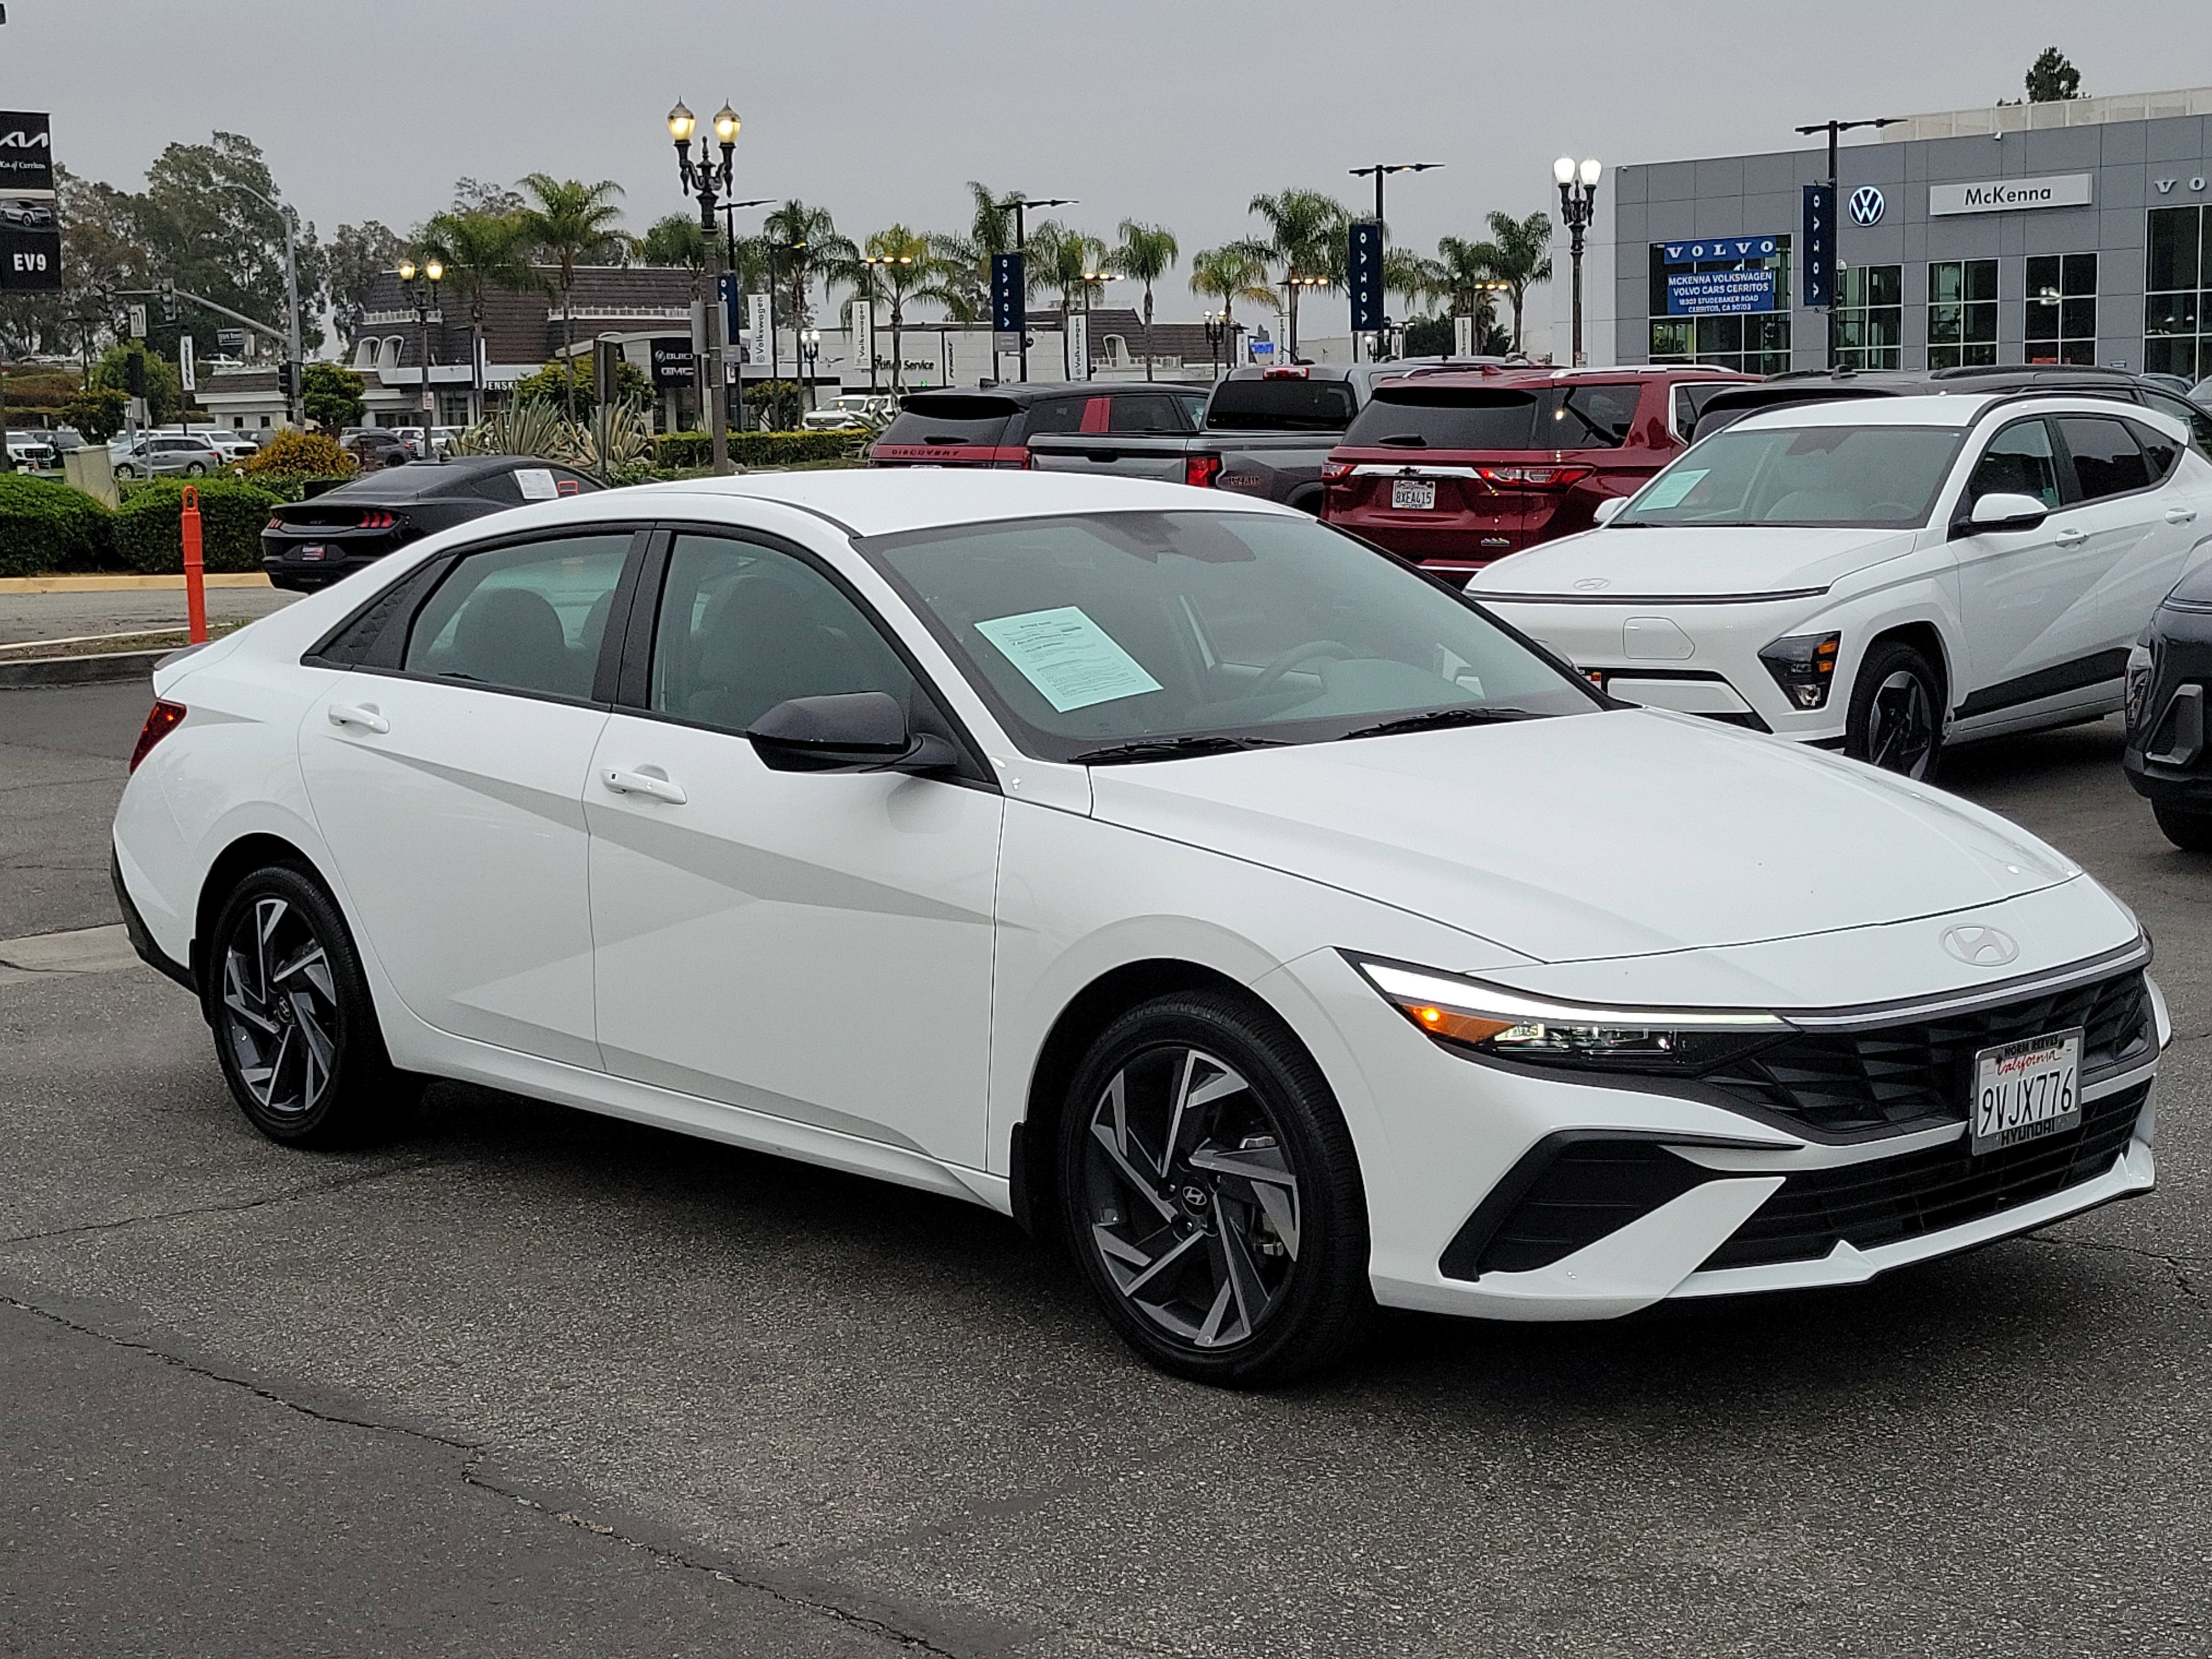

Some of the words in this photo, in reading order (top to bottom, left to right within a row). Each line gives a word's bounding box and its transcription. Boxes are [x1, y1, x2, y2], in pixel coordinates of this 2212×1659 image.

[1965, 186, 2052, 206] McKenna
[1666, 240, 1774, 258] VOLVO
[1813, 194, 1821, 298] VOLVO
[13, 254, 47, 272] EV9
[1359, 232, 1368, 325] VOLVO
[1668, 275, 1712, 286] MCKENNA
[1712, 272, 1773, 284] VOLKSWAGEN
[1002, 259, 1010, 328] VOLVO
[1673, 287, 1700, 297] VOLVO
[1701, 285, 1725, 295] CARS
[1726, 283, 1769, 294] CERRITOS
[755, 296, 765, 355] Volkswagen
[661, 366, 695, 376] GMC
[903, 359, 934, 370] Service
[891, 448, 960, 457] DISCOVERY
[1995, 1050, 2063, 1076] California
[1980, 1066, 2074, 1135] 9VJX776
[2001, 1117, 2055, 1147] HYUNDAI
